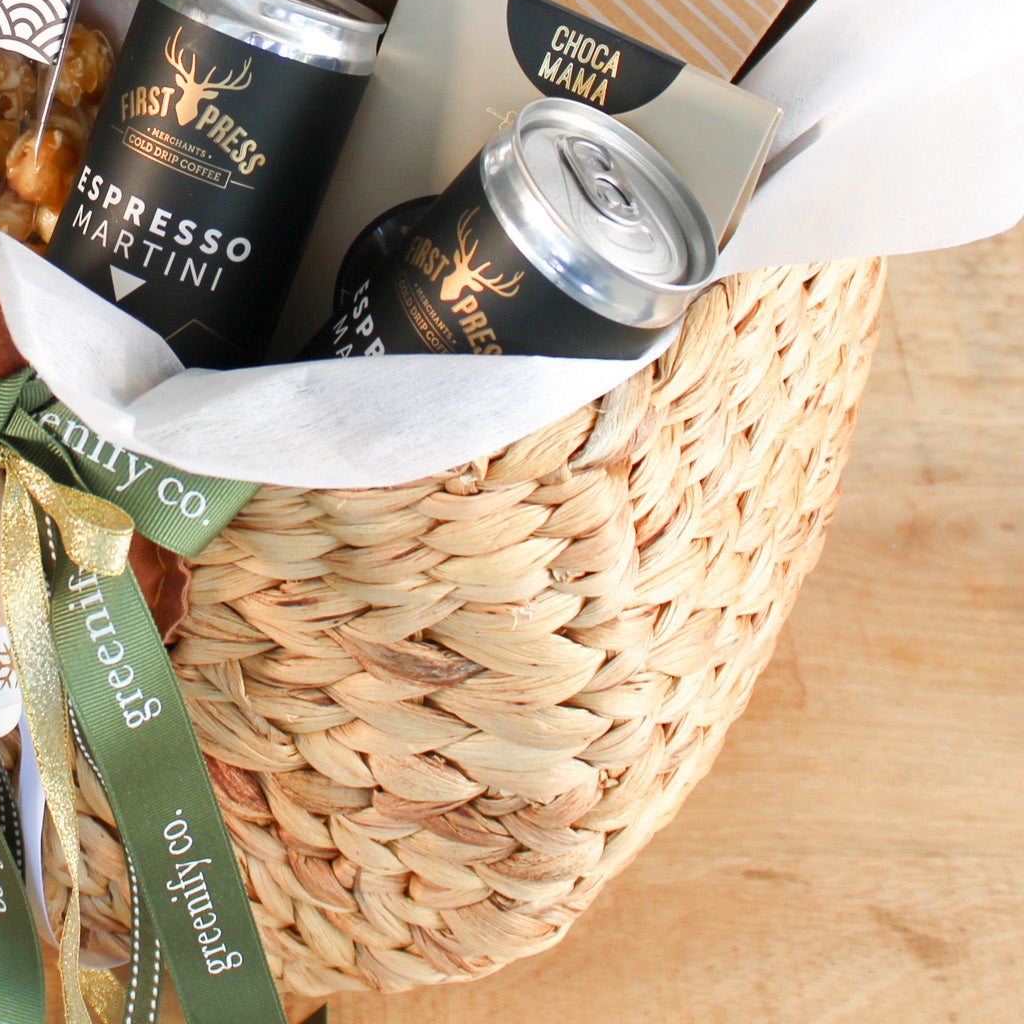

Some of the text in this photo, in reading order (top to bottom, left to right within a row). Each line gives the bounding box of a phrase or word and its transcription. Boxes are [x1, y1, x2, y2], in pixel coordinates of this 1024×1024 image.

[538, 51, 609, 106] MAMA
[551, 25, 621, 79] CHOCA
[120, 85, 267, 176] FIRST PRESS
[151, 127, 207, 158] MERCHANTS
[128, 133, 222, 183] COLD DRIP COFFEE
[77, 164, 253, 263] ESPRESSO
[72, 204, 224, 292] MARTINI
[404, 235, 450, 282] FIRST
[398, 279, 414, 308] COLD
[409, 305, 429, 331] DRIP
[416, 287, 453, 340] MERCHANTS
[157, 476, 210, 526] co.
[68, 566, 162, 729] greenif
[163, 808, 243, 975] greenify co.
